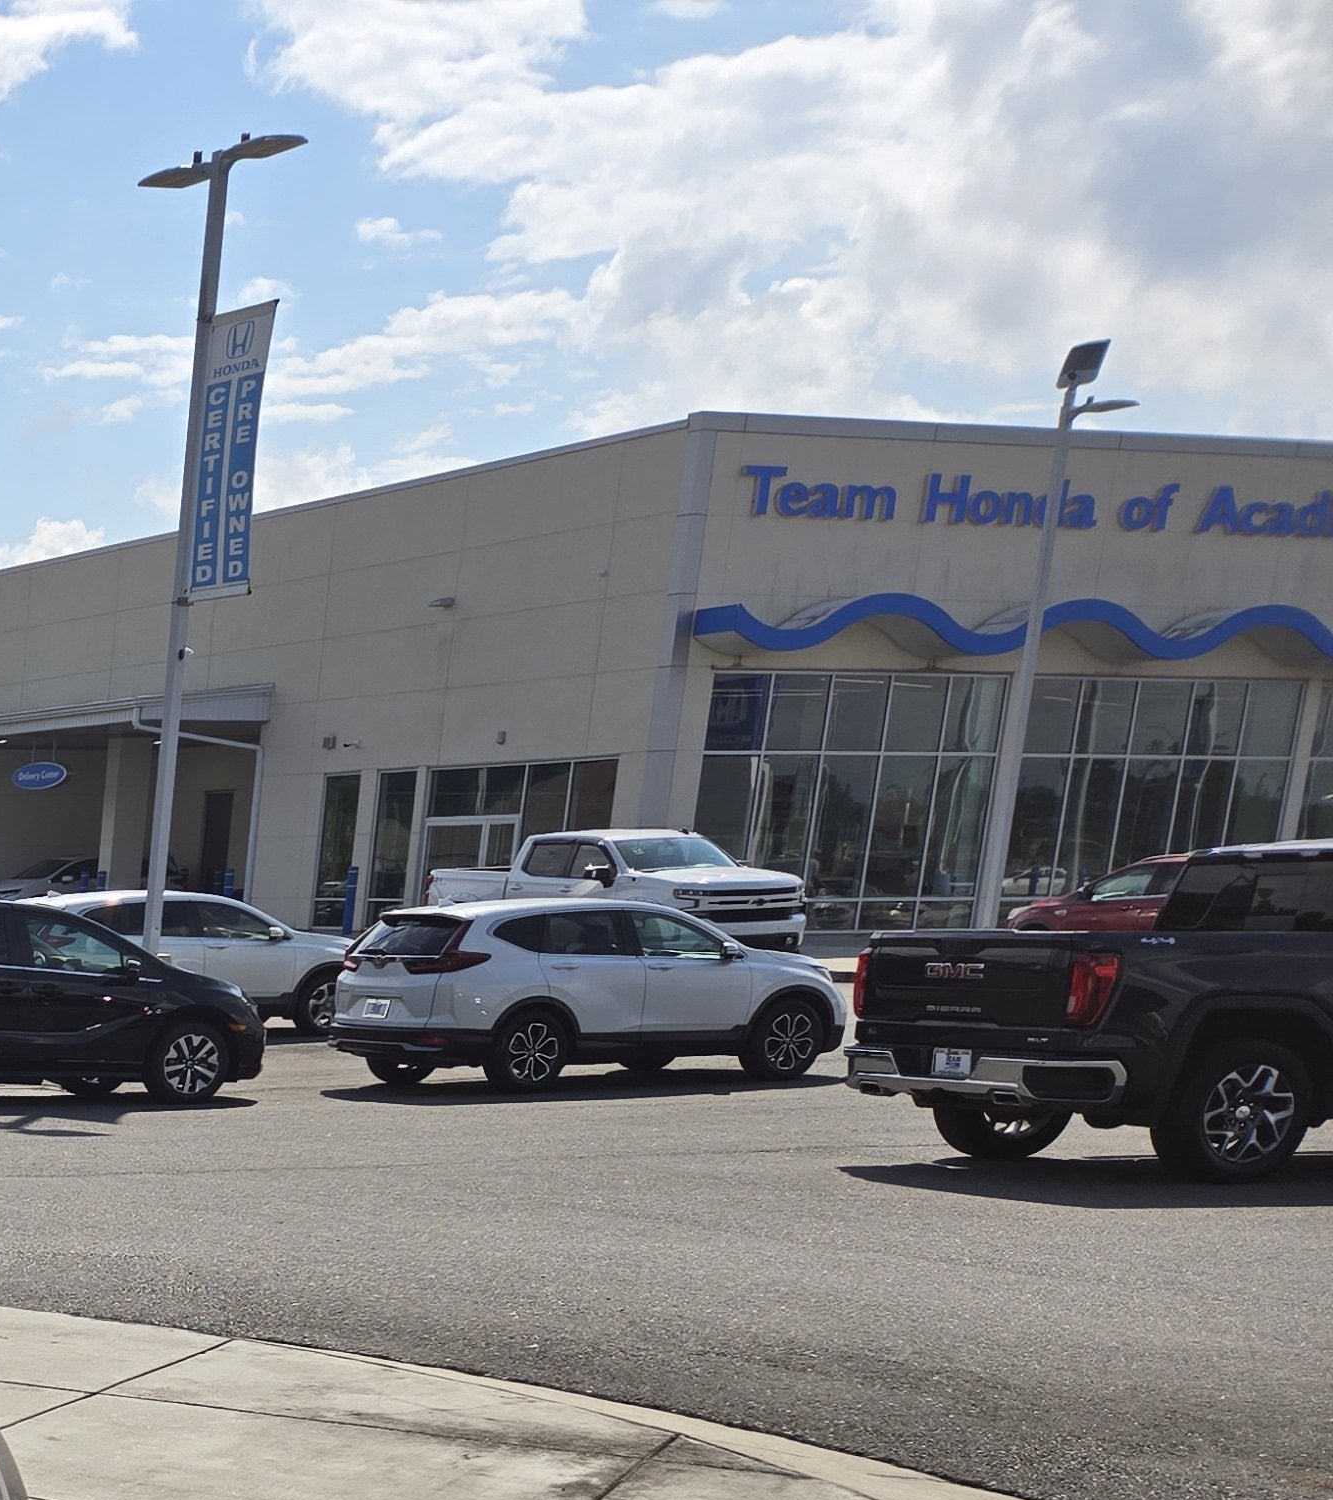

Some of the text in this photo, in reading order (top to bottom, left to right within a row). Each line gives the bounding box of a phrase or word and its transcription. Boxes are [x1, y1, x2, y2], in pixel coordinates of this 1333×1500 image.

[213, 358, 260, 378] HONDA
[196, 387, 227, 582] CERTIFIED
[228, 379, 257, 578] PRE OWNED
[744, 465, 896, 520] Team
[923, 473, 1097, 529] Honda
[1120, 483, 1180, 532] of
[18, 770, 59, 781] Delivery Center
[925, 962, 985, 980] GMC
[926, 1005, 982, 1013] SIERRA
